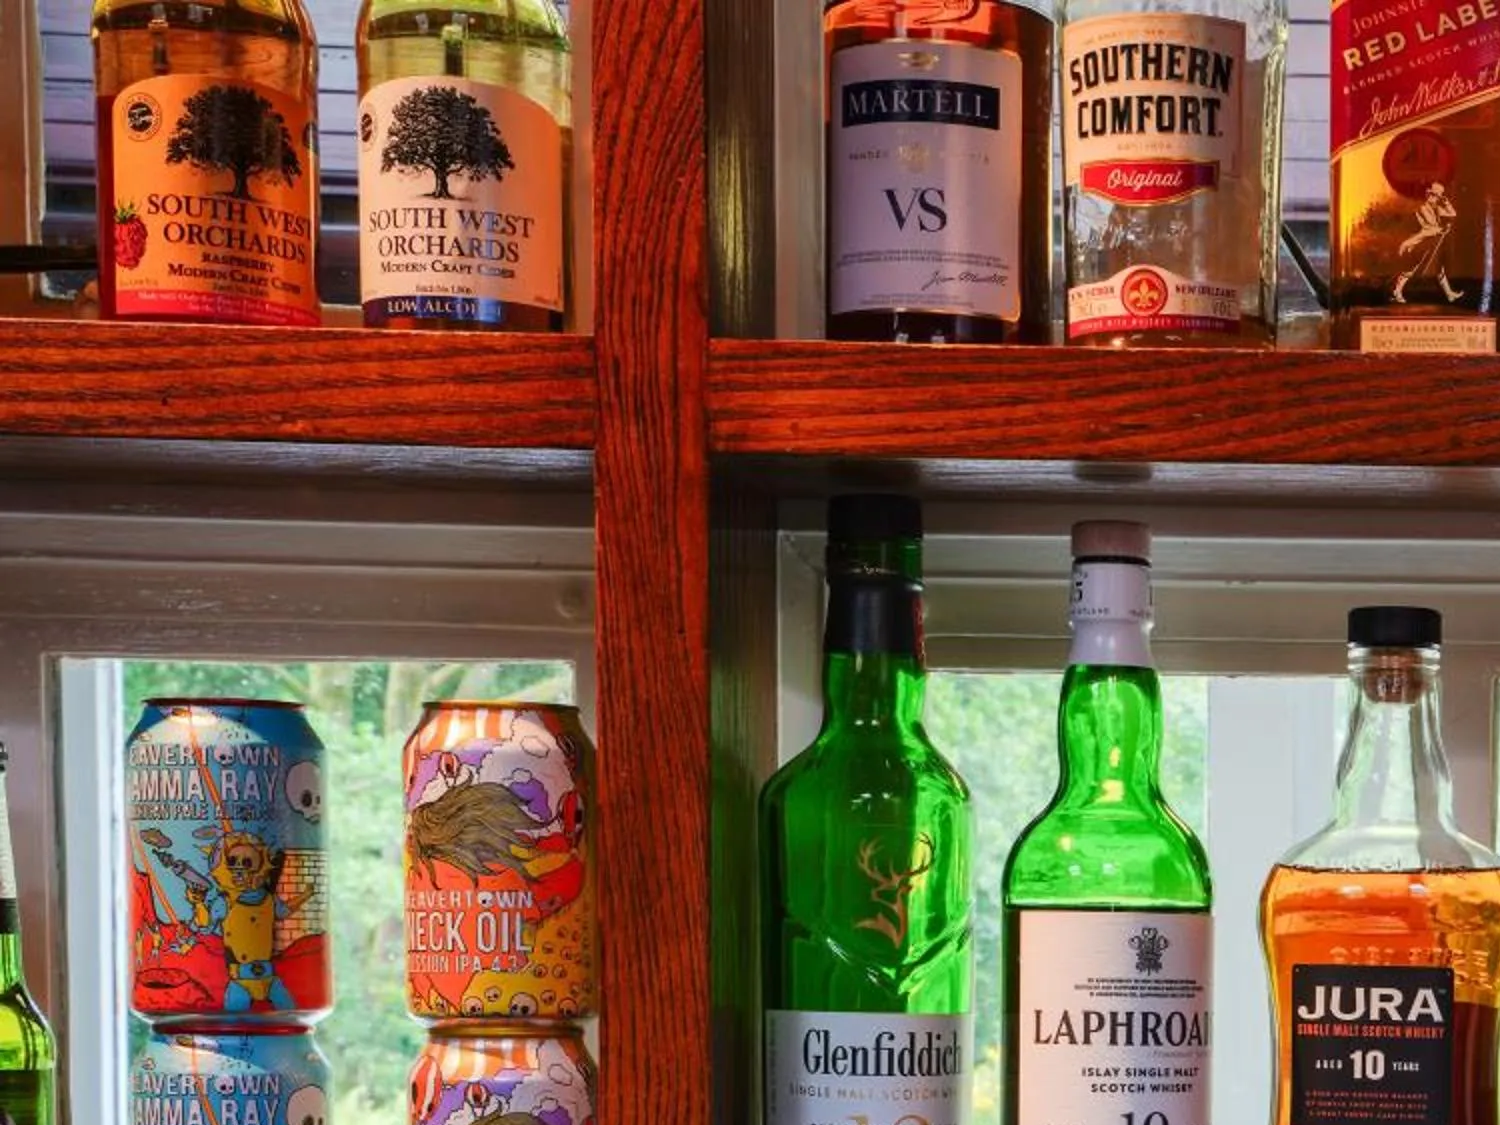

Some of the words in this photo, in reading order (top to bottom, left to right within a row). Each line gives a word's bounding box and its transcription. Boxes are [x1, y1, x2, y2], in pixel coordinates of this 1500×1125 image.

[1343, 31, 1407, 71] RED
[1068, 42, 1234, 96] SOUTHERN
[849, 87, 990, 120] MARTELL
[1106, 166, 1184, 191] Original
[147, 193, 248, 224] SOUTH
[369, 207, 447, 233] SOUTH
[457, 209, 535, 239] WEST
[882, 186, 948, 233] VS
[163, 222, 306, 264] ORCHARDS
[378, 235, 521, 263] ORCHARDS
[380, 261, 428, 274] MODERN
[431, 260, 474, 275] CRAFT
[387, 300, 418, 314] LOW
[220, 769, 279, 802] RAY
[476, 910, 534, 953] OIL
[454, 955, 483, 974] IPA
[1296, 985, 1444, 1023] JURA
[1296, 1023, 1330, 1037] SINGLE
[1332, 1024, 1360, 1038] MALT
[1361, 1025, 1402, 1039] SCOTCH
[1404, 1026, 1446, 1040] WHISKY
[802, 1028, 963, 1078] Glenfiddich
[1349, 1049, 1386, 1081] 10
[1392, 1061, 1420, 1072] YEARS
[1081, 1066, 1121, 1078] ISLAY
[1124, 1066, 1171, 1078] SINGLE
[1173, 1067, 1200, 1078] MALT
[1090, 1083, 1146, 1094] SCOTCH
